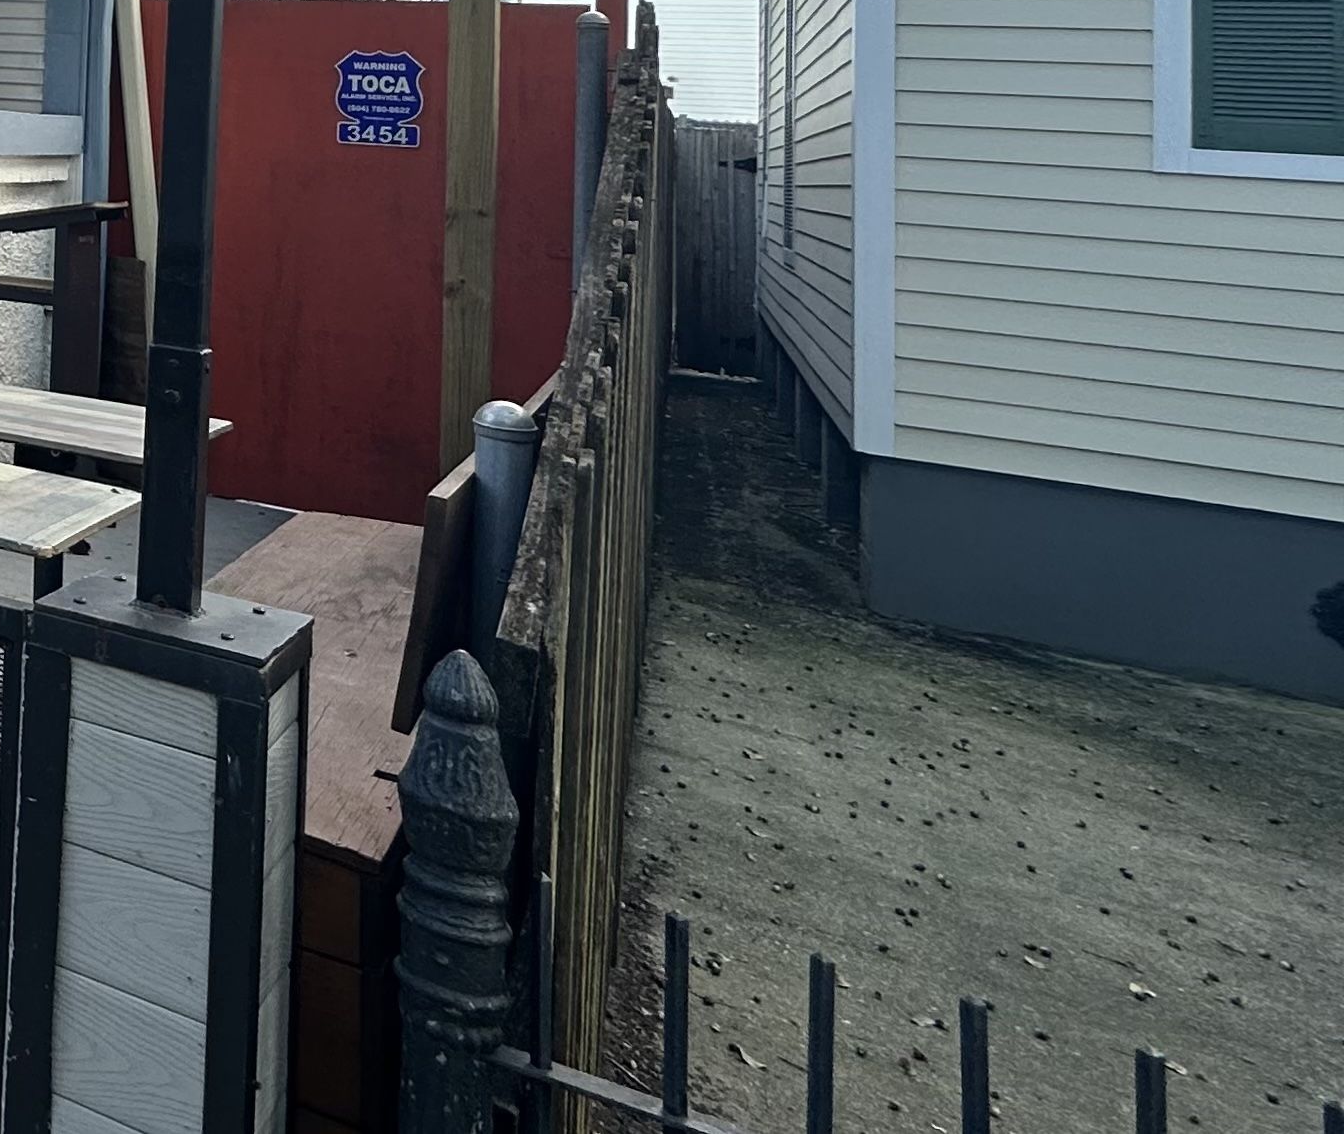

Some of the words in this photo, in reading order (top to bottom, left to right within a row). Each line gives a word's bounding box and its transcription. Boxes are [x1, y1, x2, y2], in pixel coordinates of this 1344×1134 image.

[353, 61, 406, 72] WARNING
[347, 74, 411, 94] TOCA
[347, 125, 409, 145] 3454
